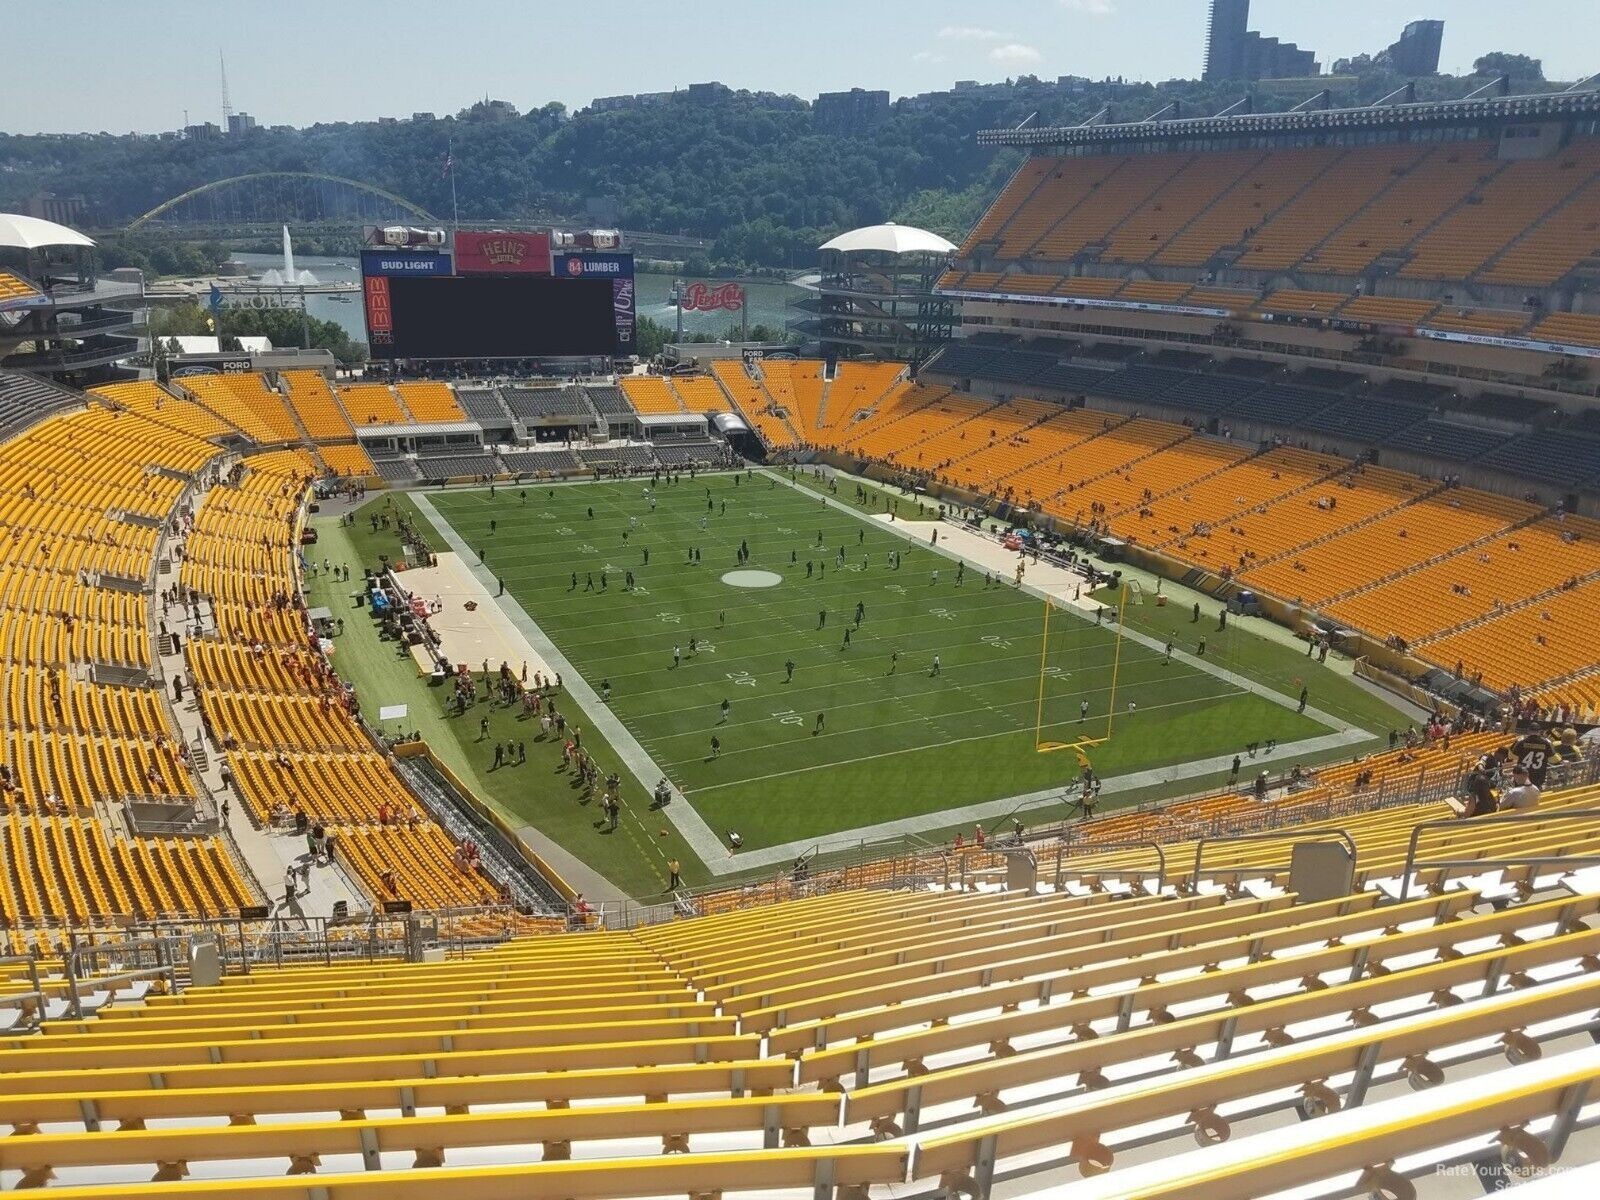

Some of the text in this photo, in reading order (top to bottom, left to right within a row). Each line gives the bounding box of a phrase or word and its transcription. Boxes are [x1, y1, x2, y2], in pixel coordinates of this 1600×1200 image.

[482, 240, 525, 257] HEINZ
[381, 261, 434, 270] BUD LIGHT
[583, 262, 620, 272] LUMBER
[223, 361, 250, 369] FORD
[725, 671, 756, 686] 20
[771, 709, 803, 725] 10
[1522, 751, 1545, 769] 43
